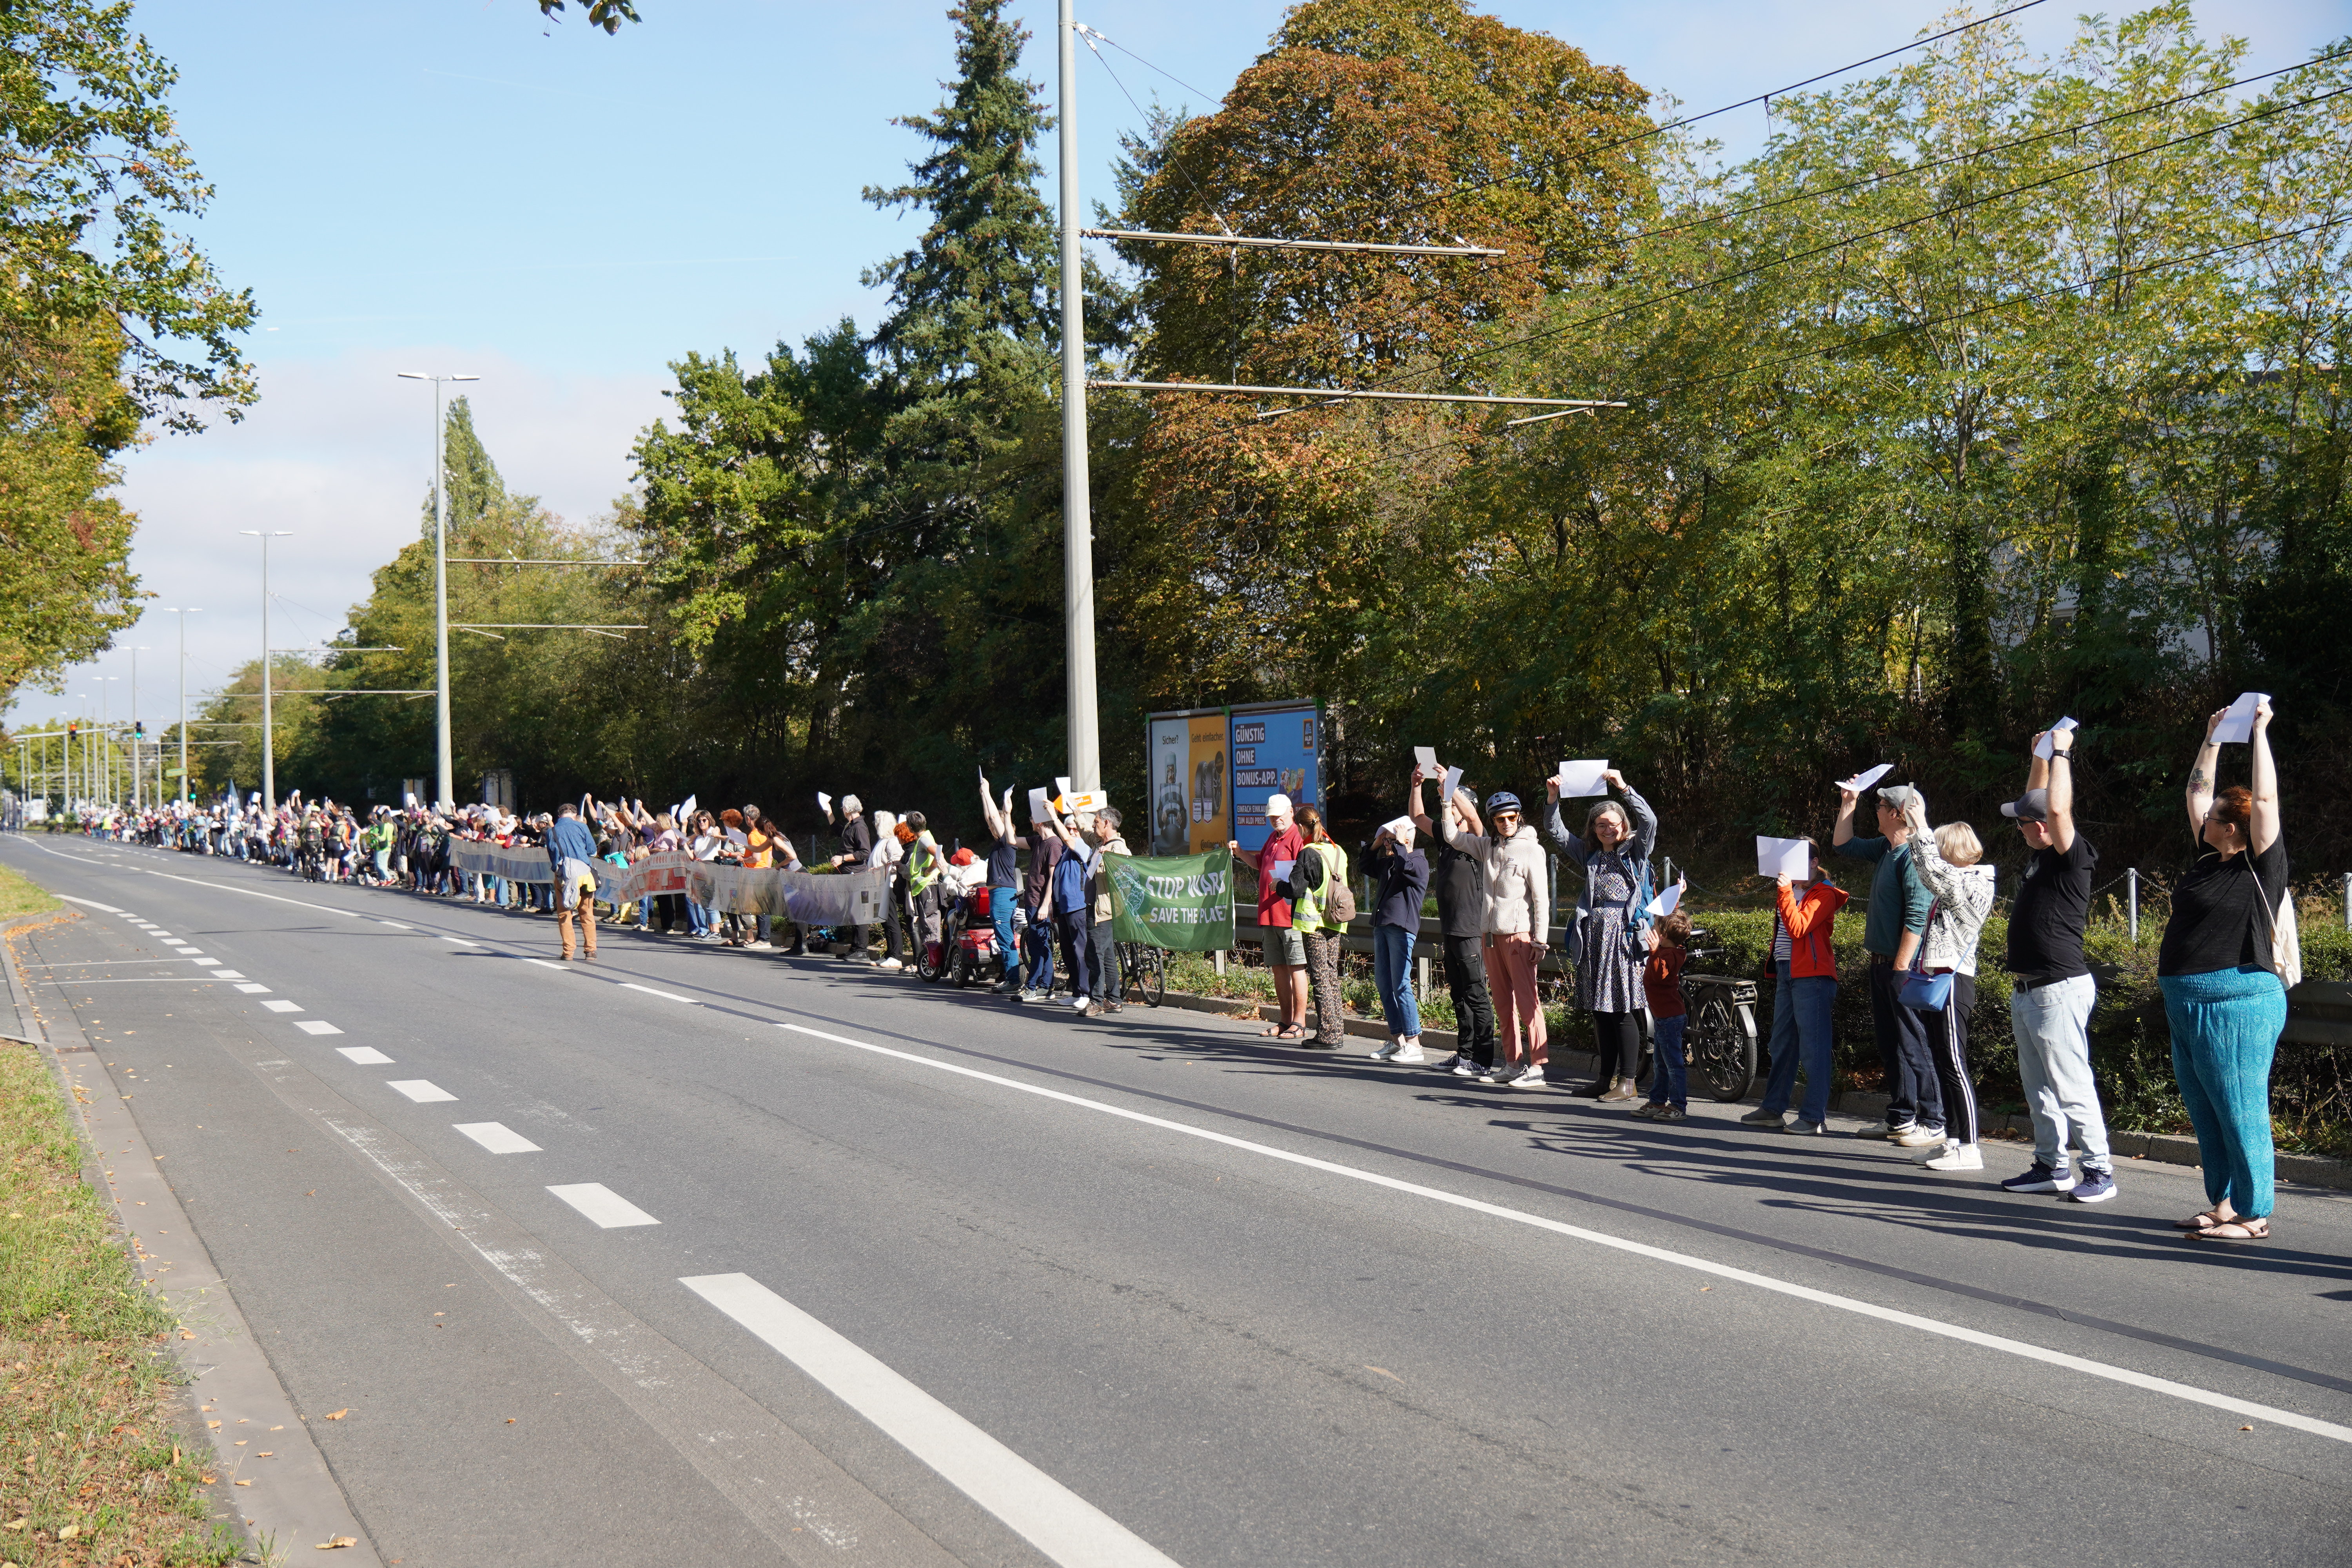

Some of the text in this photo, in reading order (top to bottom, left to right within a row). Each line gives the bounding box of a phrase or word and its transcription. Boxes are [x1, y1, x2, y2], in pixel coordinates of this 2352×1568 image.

[1163, 735, 1178, 744] Sicher?
[1192, 732, 1224, 743] Geht einfacher.
[1236, 725, 1265, 742] GÜNSTIG
[1236, 750, 1254, 764] OHNE
[1237, 771, 1277, 785] BONUS-APP.
[1113, 864, 1136, 877] WRKERS
[1146, 870, 1225, 899] STOP WARS
[1150, 907, 1178, 923] SAVE
[1180, 908, 1198, 924] THE
